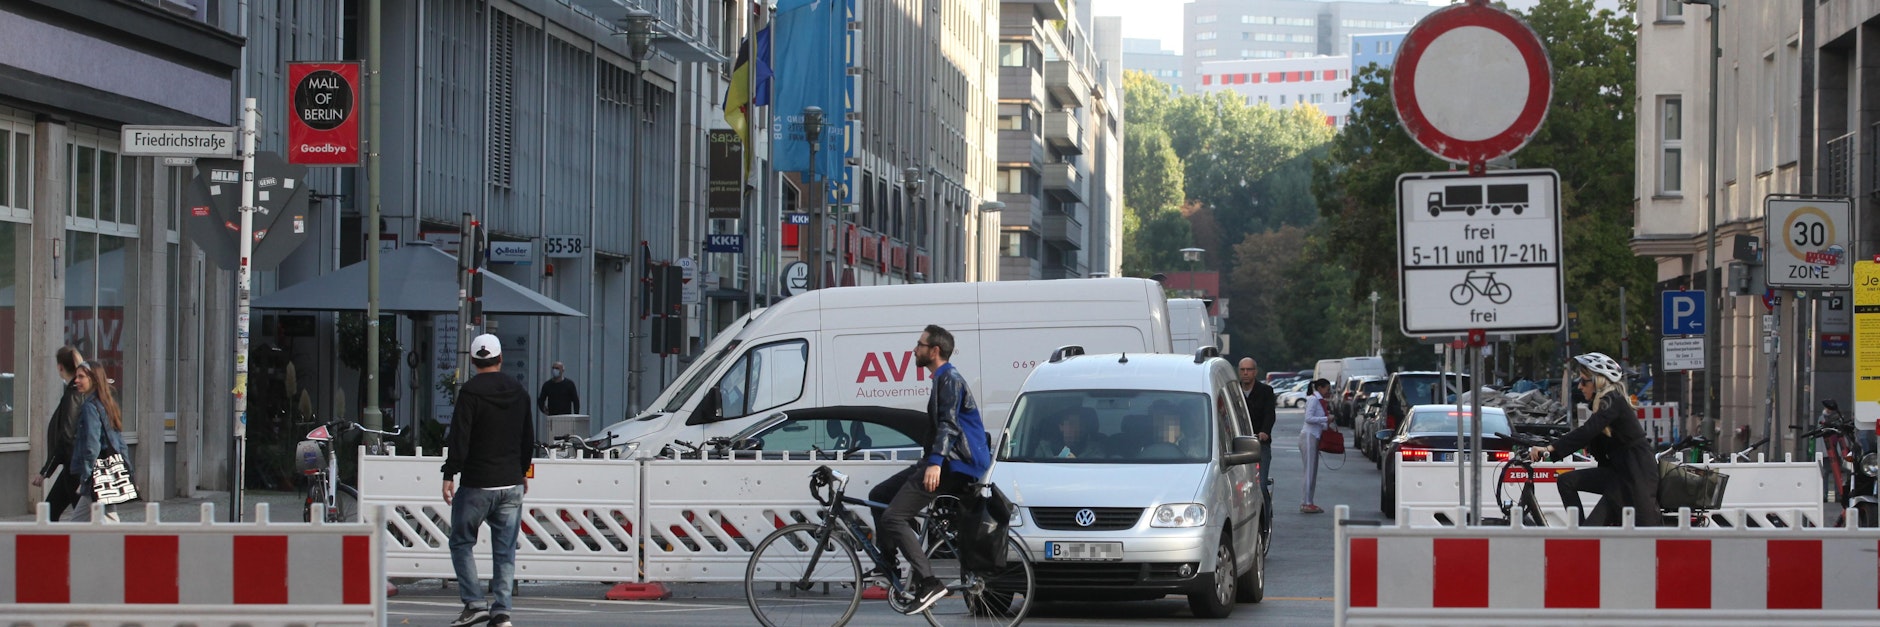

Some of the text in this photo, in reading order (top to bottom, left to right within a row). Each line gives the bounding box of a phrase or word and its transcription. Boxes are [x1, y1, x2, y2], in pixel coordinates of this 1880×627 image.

[308, 77, 339, 89] MALL
[314, 92, 333, 105] OF
[304, 108, 343, 120] BERLIN
[134, 131, 226, 150] Friedrichstraße
[300, 143, 347, 155] Goodbye
[211, 170, 239, 181] MLM
[1464, 223, 1495, 240] frei
[1794, 221, 1825, 247] 30
[548, 237, 582, 254] 55-58
[711, 236, 739, 245] KKH
[1412, 243, 1548, 265] 5-11 und 17-21h
[1788, 265, 1830, 279] ZONE
[1861, 275, 1880, 288] Je
[1832, 298, 1841, 309] P
[1470, 308, 1497, 322] frei
[1672, 296, 1696, 330] P
[856, 351, 934, 383] AVI
[856, 387, 931, 399] Autovermiet
[1053, 543, 1061, 556] B
